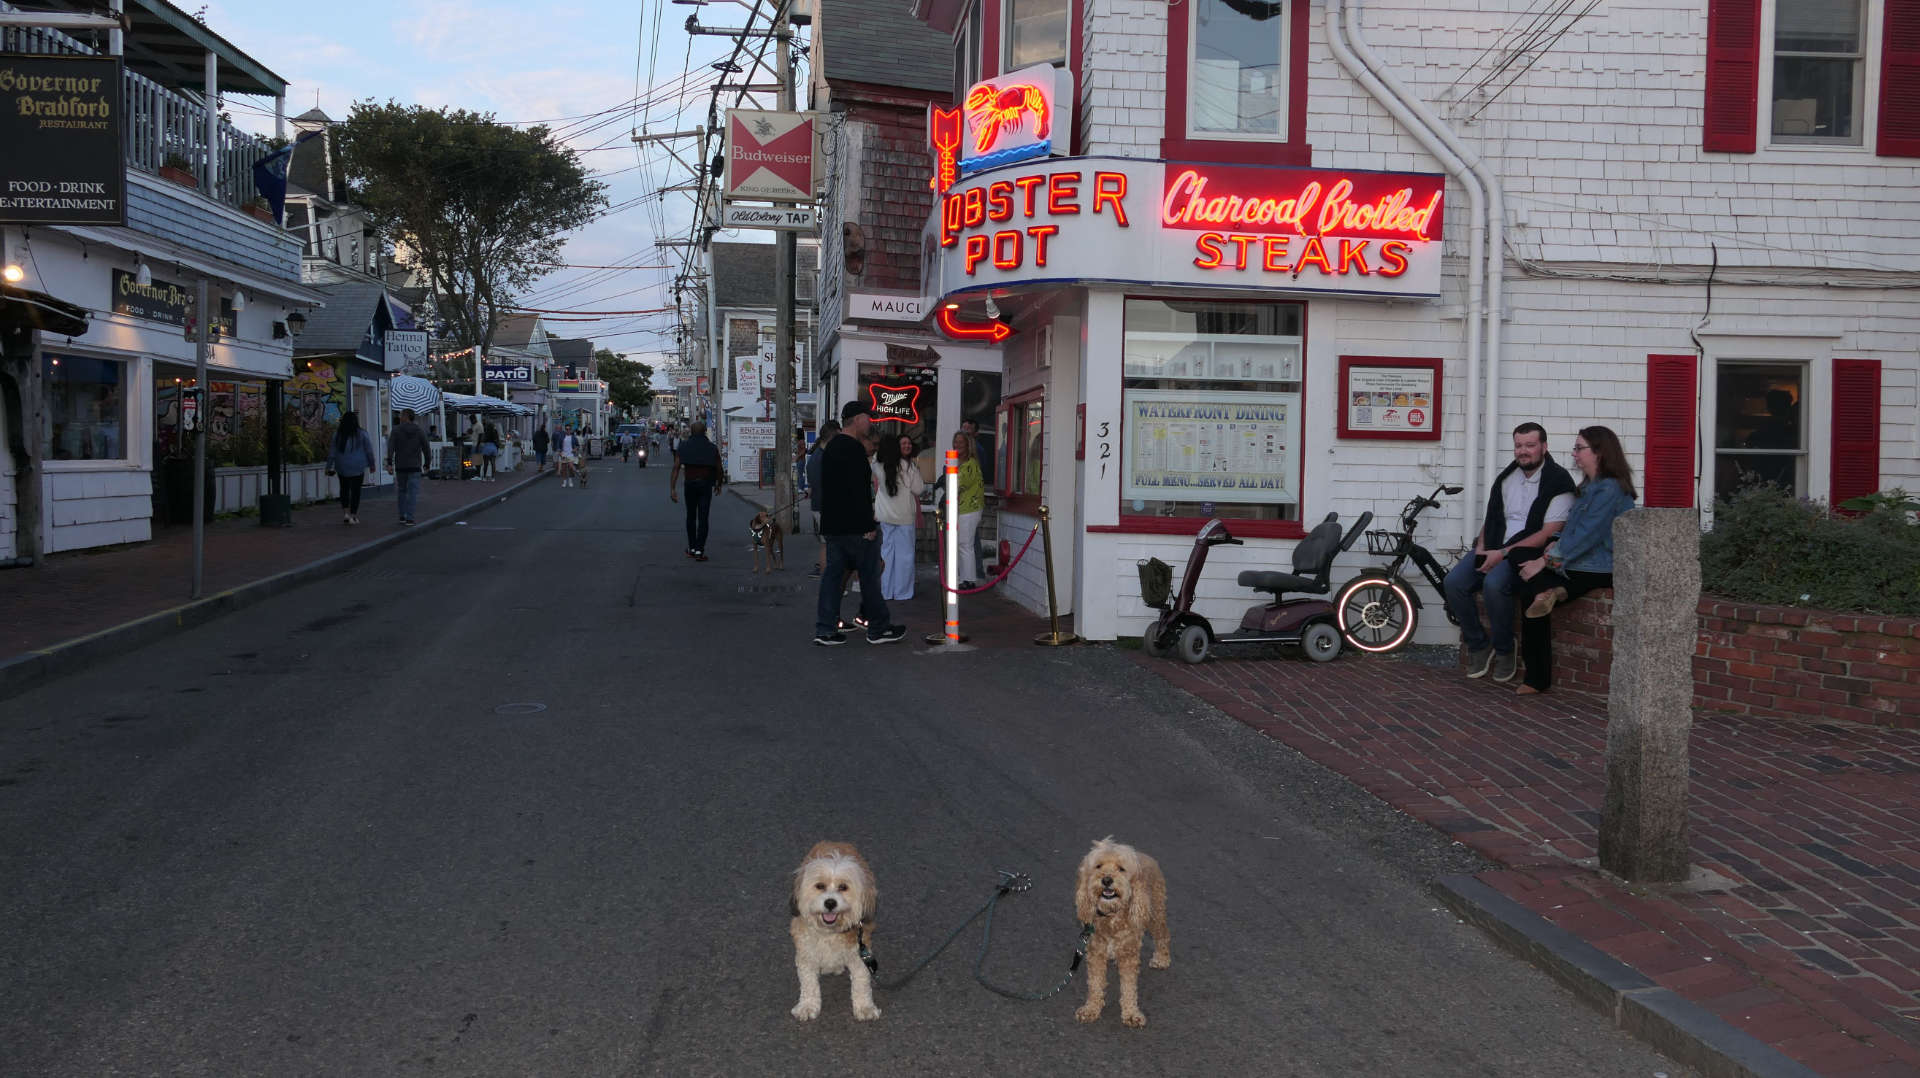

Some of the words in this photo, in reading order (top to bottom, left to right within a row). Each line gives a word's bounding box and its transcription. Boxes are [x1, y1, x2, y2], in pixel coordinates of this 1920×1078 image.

[0, 67, 102, 93] Governor
[16, 95, 110, 118] Bradford
[39, 119, 109, 129] RESTAURANT
[732, 145, 810, 163] Budweiser
[8, 181, 51, 192] FOOD
[60, 182, 105, 194] DRINK
[0, 197, 116, 210] ENTERTAINMENT
[941, 171, 1130, 248] LOBSTER
[1164, 170, 1323, 237] Charcoal
[1318, 178, 1443, 242] Broiled
[731, 211, 749, 222] Old
[749, 212, 784, 225] Colony
[785, 213, 810, 224] TAP
[966, 225, 1060, 276] POT
[1193, 232, 1413, 278] STEAKS
[126, 305, 144, 315] FOOD
[386, 331, 423, 342] Henna
[386, 342, 422, 352] Tattoo
[485, 370, 528, 379] PATIO
[881, 392, 908, 406] Miller
[876, 405, 894, 414] HIGH
[894, 406, 911, 415] LIFE
[1138, 405, 1230, 420] WATERFRONT
[1235, 407, 1285, 421] DINING
[1097, 422, 1111, 480] 321
[1135, 476, 1159, 486] FULL
[1238, 478, 1257, 489] ALL
[1260, 478, 1284, 489] DAY!
